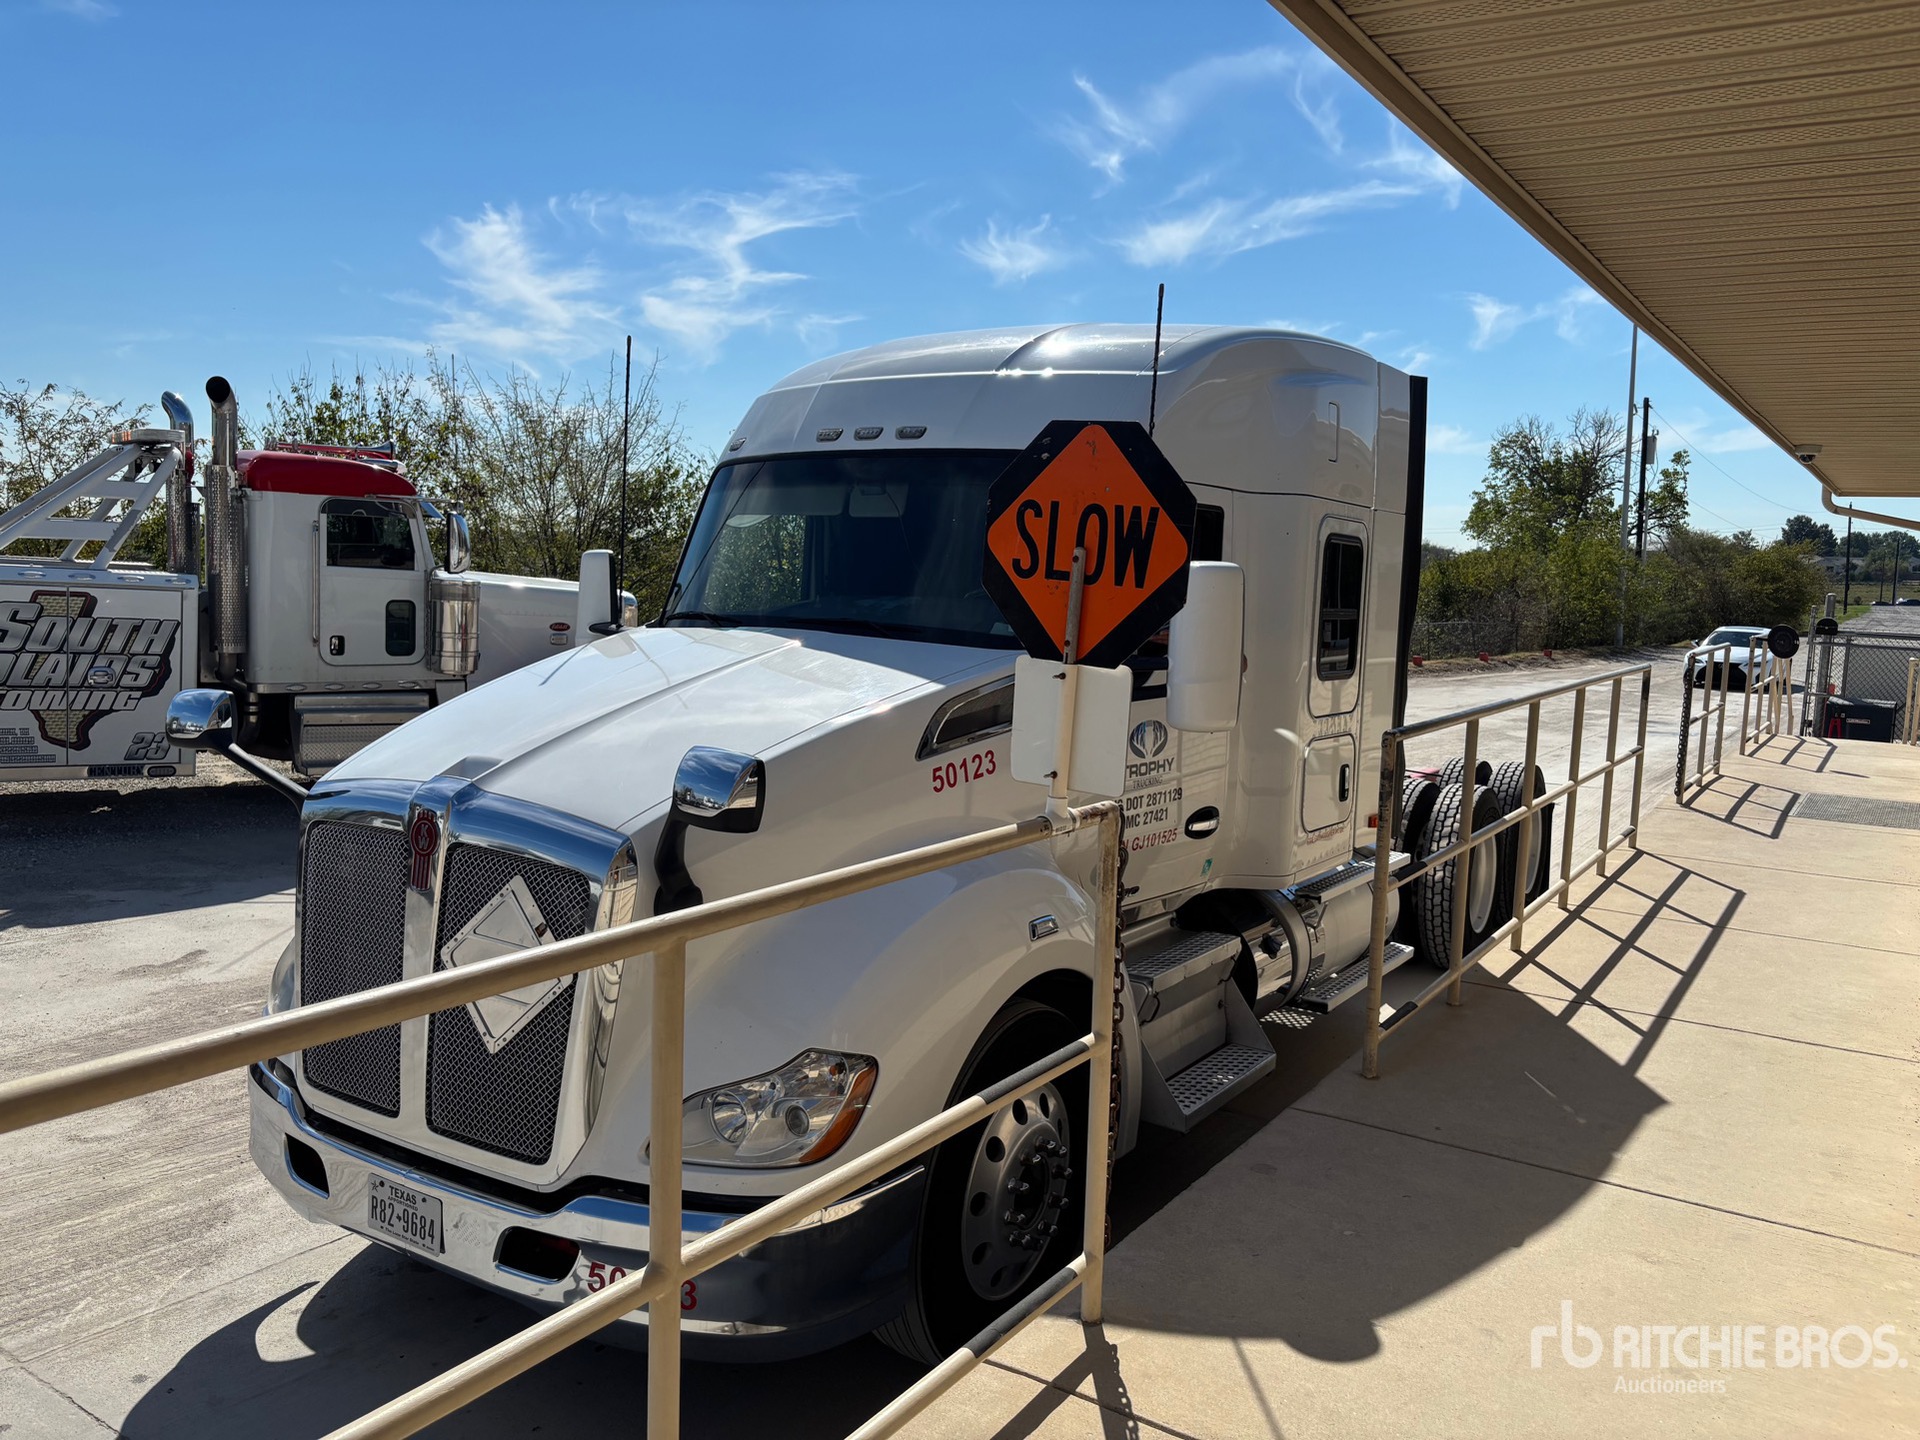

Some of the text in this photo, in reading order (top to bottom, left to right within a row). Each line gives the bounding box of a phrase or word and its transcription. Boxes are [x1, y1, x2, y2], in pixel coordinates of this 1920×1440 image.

[1012, 499, 1160, 589] SLOW
[0, 601, 181, 654] SOUTH
[124, 731, 171, 760] 23
[932, 750, 996, 793] 50123
[1132, 776, 1163, 790] TRUCKING
[1126, 795, 1144, 811] DOT
[1146, 787, 1183, 807] 2871129
[1125, 807, 1169, 829] MC 27421
[1131, 828, 1178, 851] GJ101525
[387, 1195, 419, 1212] APPORTIONED
[389, 1185, 417, 1205] TEXAS
